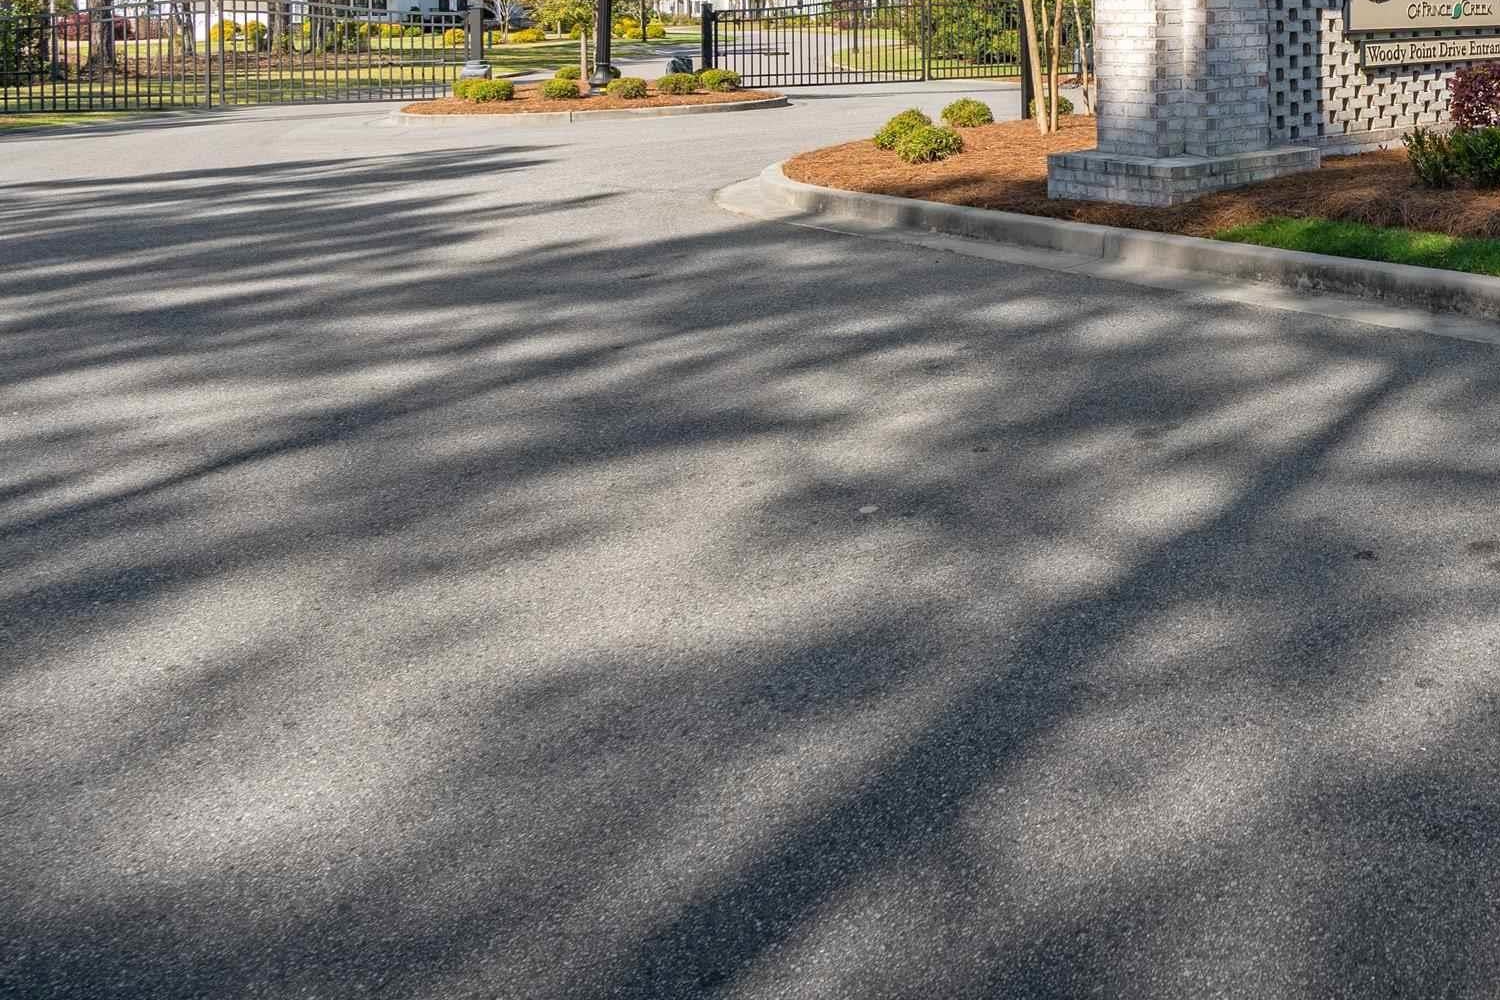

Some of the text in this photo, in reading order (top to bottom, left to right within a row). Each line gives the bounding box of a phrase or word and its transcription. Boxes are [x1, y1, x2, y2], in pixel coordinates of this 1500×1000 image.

[1462, 0, 1493, 17] CREEK
[1367, 44, 1406, 63] Woody
[1409, 43, 1437, 59] Point
[1439, 42, 1467, 58] Drive
